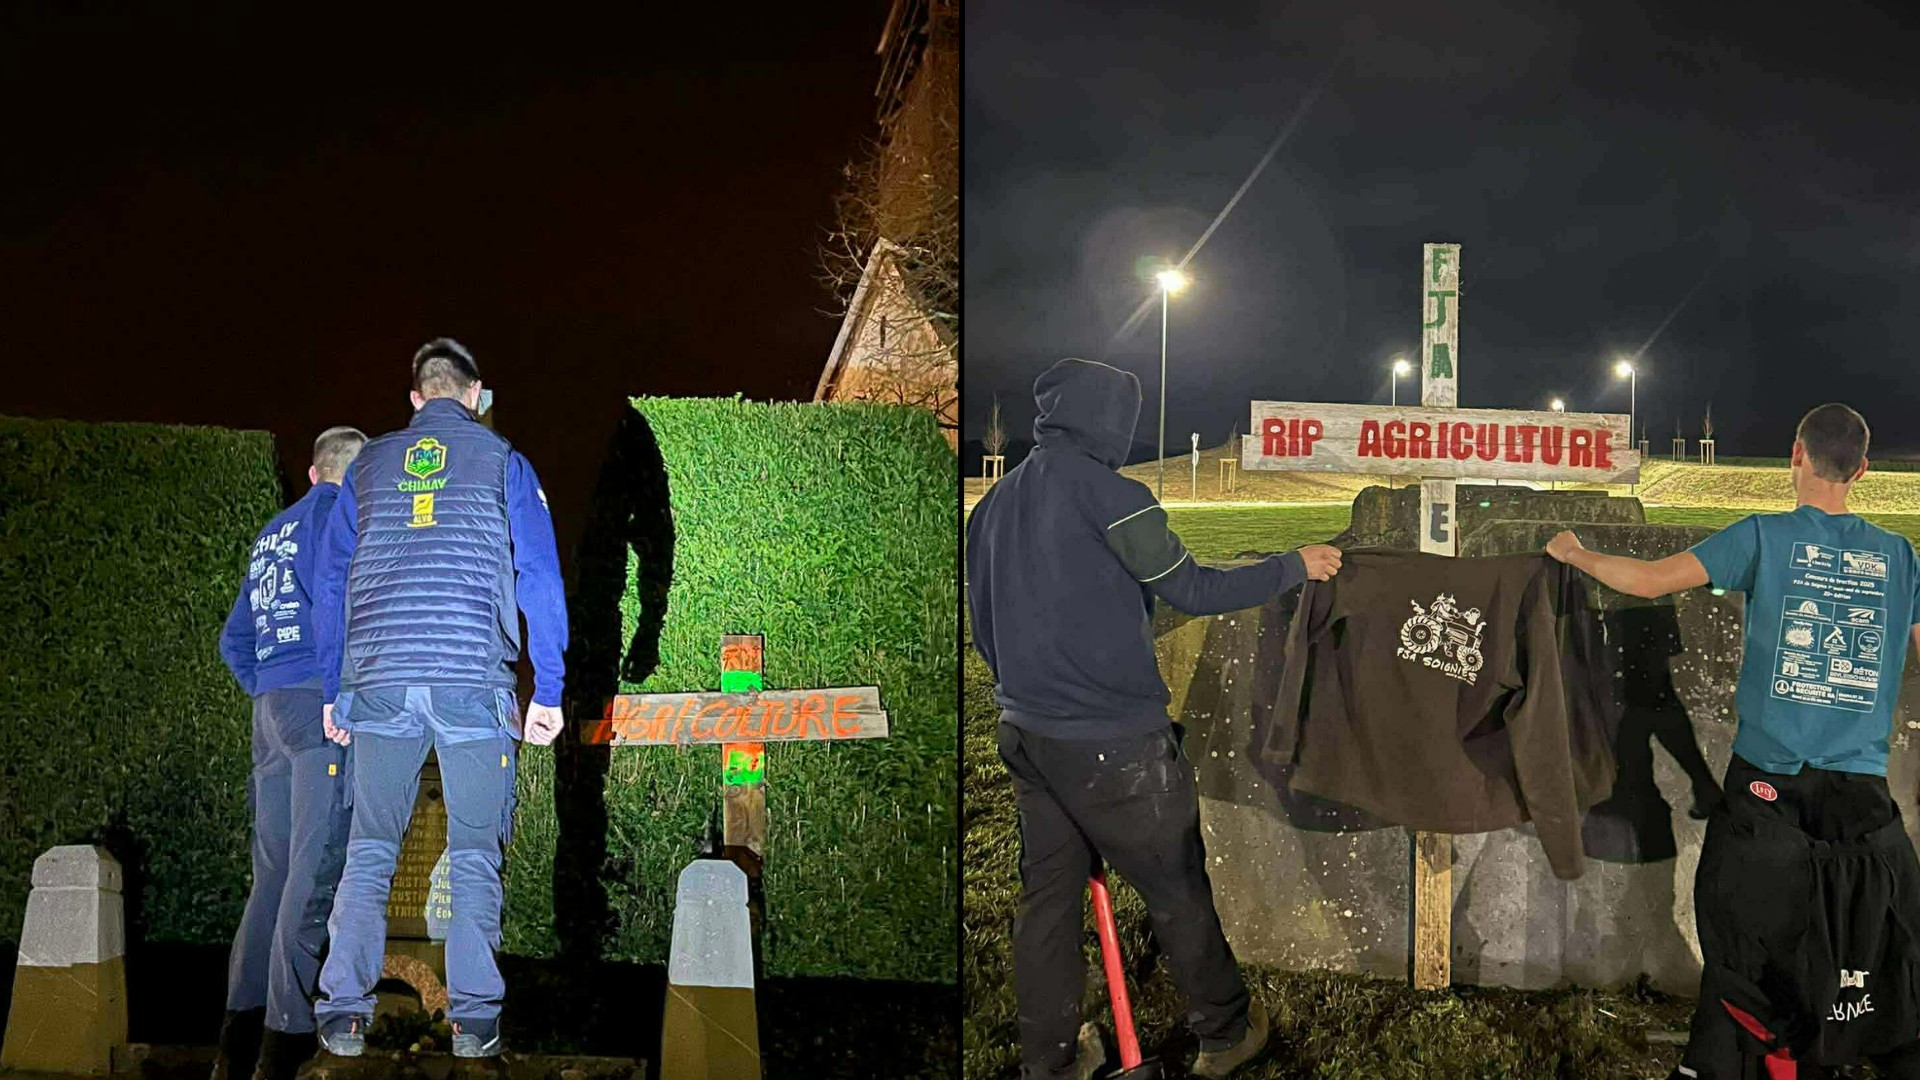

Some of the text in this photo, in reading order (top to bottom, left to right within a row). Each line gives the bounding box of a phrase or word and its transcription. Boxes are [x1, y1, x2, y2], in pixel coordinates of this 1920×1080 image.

[1262, 418, 1614, 469] RIP AGRICULTURE
[398, 479, 447, 492] CHIMAY
[1422, 656, 1478, 682] SOIGNIES
